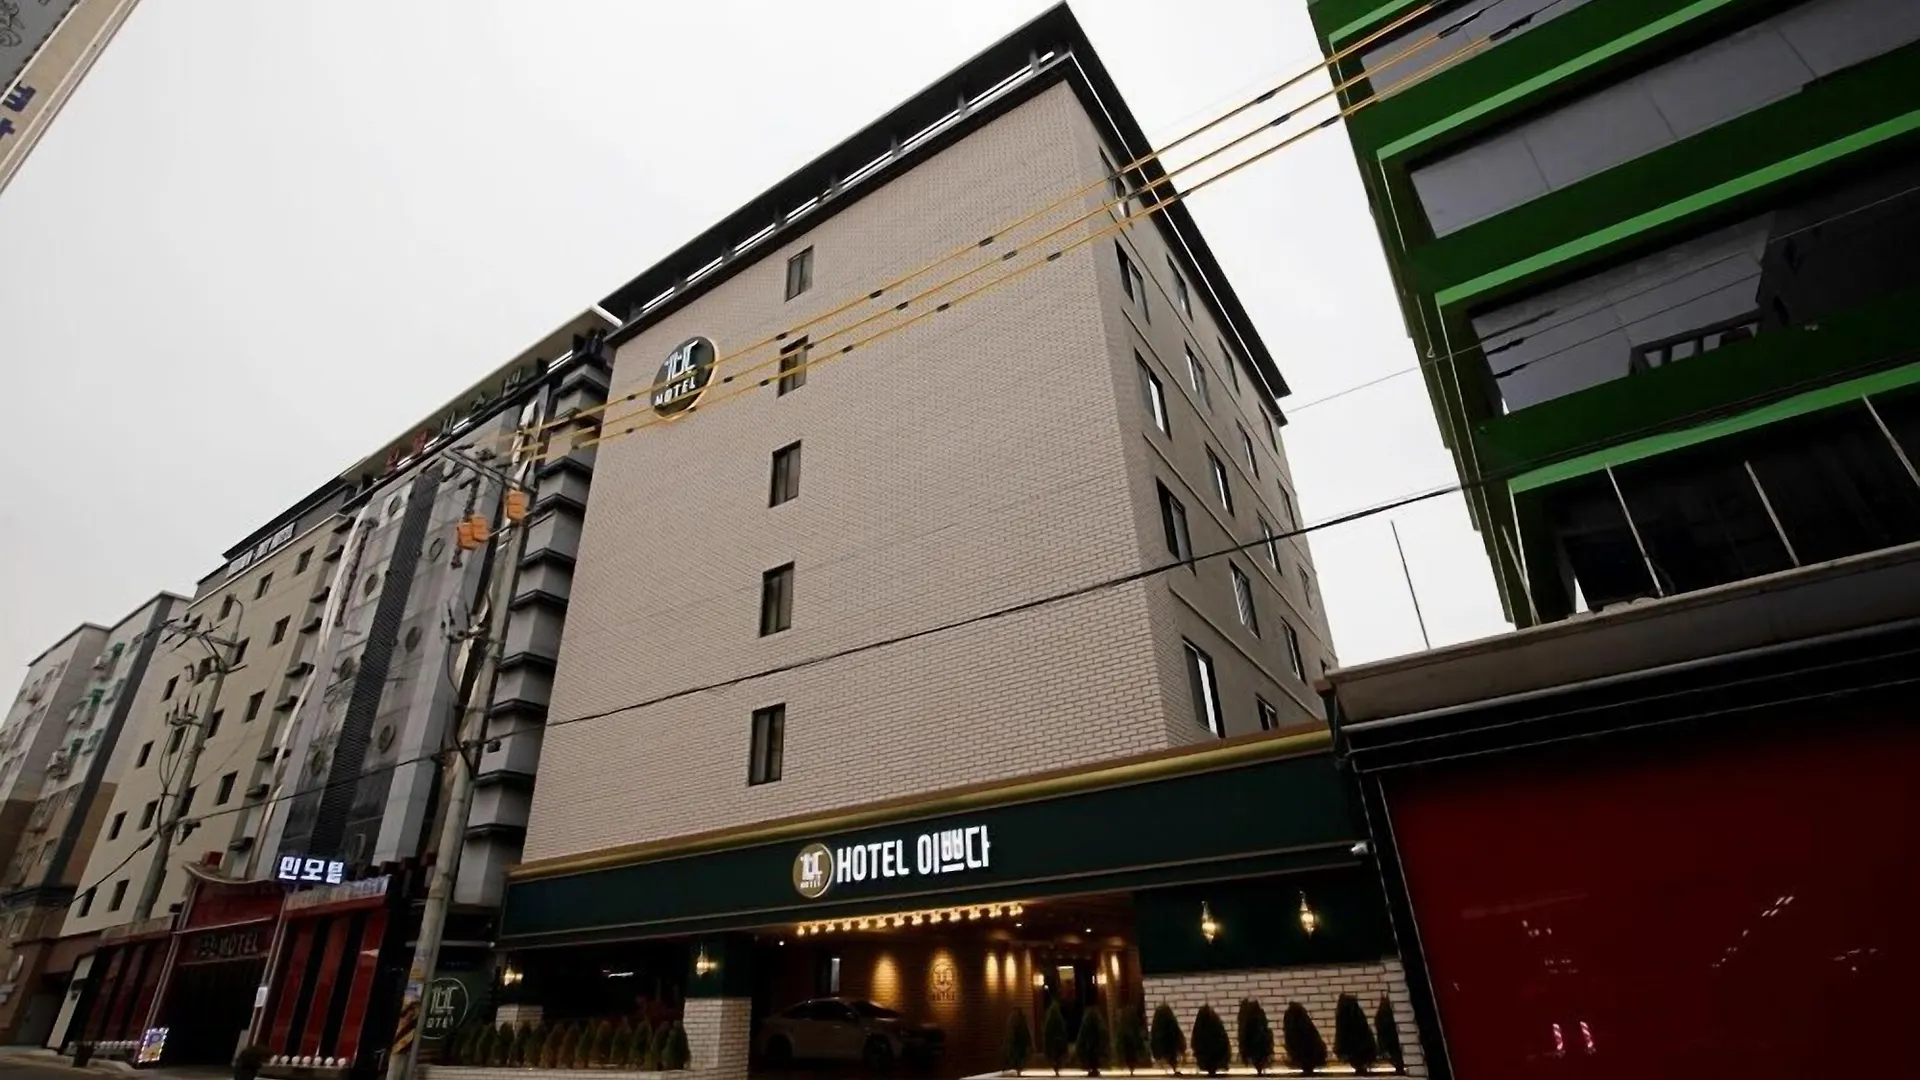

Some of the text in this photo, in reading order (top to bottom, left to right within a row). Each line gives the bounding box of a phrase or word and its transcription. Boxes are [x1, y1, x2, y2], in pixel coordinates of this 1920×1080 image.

[836, 825, 991, 883] HOTEL 이쁘다
[426, 1014, 454, 1029] OTEL
